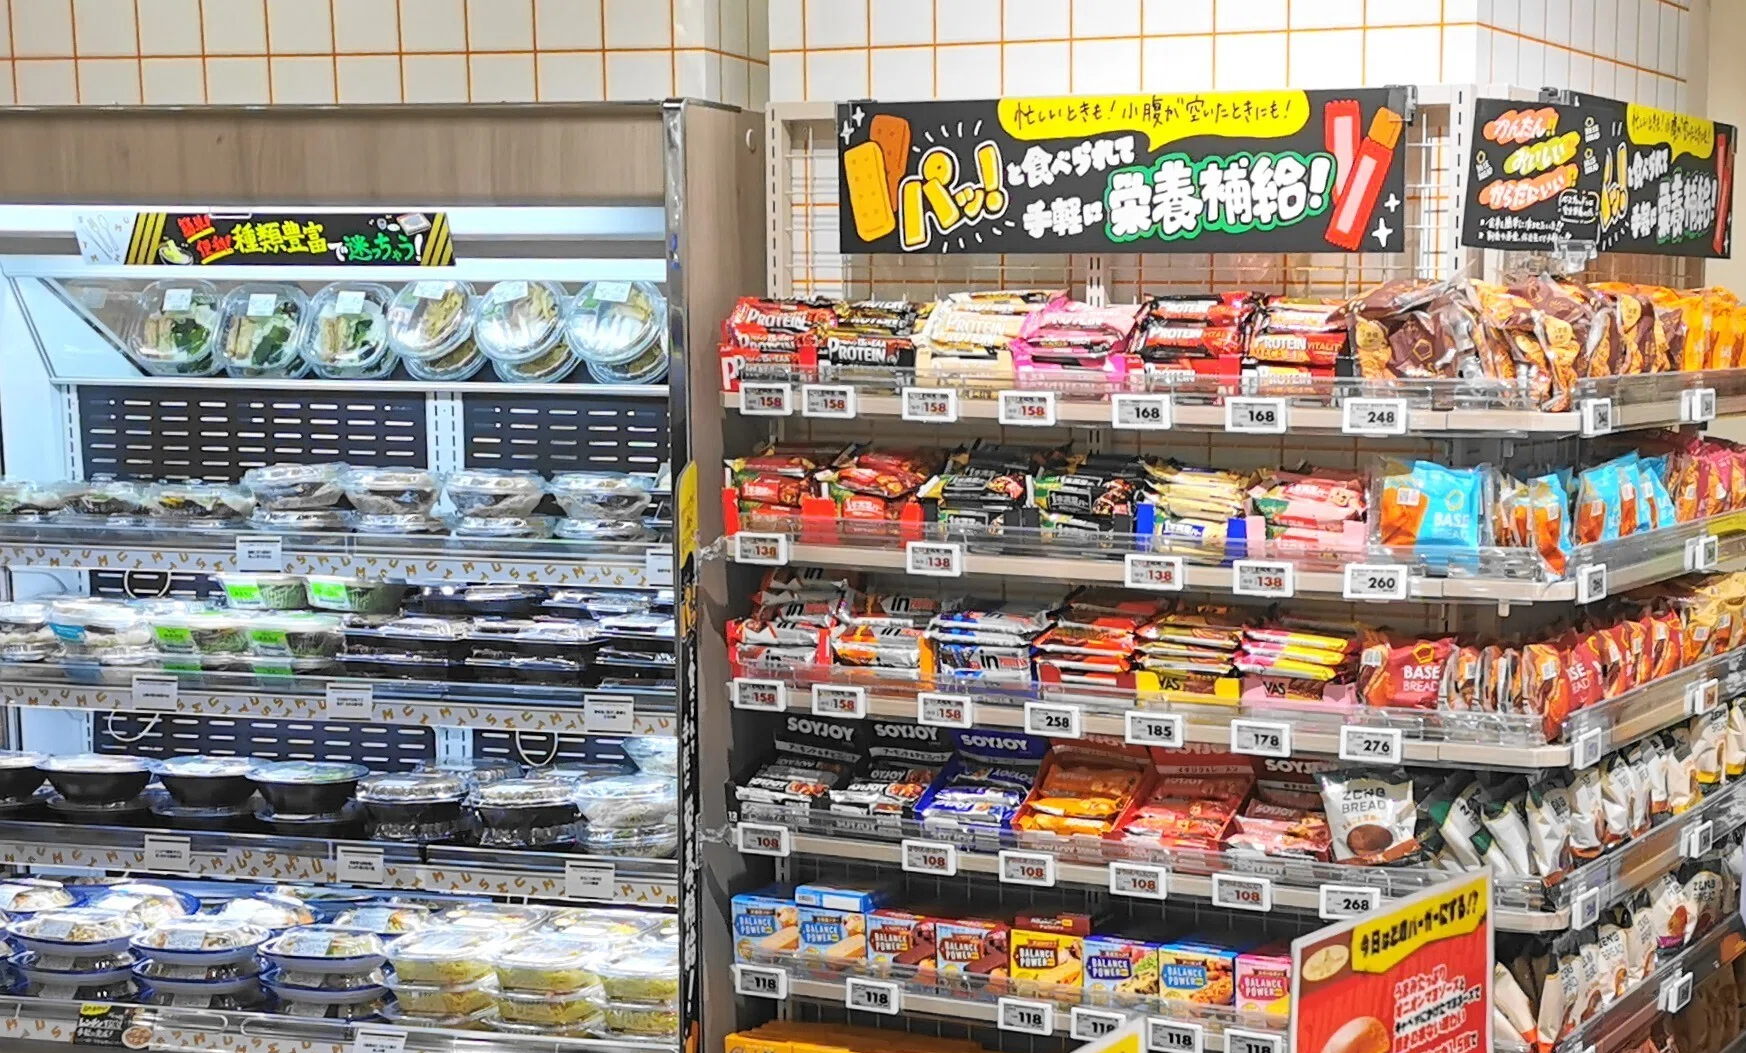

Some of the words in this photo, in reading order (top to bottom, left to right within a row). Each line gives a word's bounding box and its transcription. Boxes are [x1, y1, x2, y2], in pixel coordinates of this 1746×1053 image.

[1007, 136, 1135, 187] と食べられて
[1108, 152, 1334, 233] 栄養補給!
[1023, 199, 1103, 238] 手軽に
[1254, 335, 1307, 351] PROTEIN
[828, 337, 887, 363] PROTEIN
[760, 396, 782, 407] 158
[824, 399, 845, 410] 158
[924, 402, 946, 413] 158
[1021, 404, 1045, 416] 158
[1135, 406, 1160, 419] 168
[1248, 409, 1275, 423] 168
[1367, 410, 1394, 424] 248
[755, 545, 776, 557] 138
[928, 557, 950, 568] 138
[1148, 570, 1173, 582] 138
[1258, 577, 1282, 588] 138
[1368, 577, 1395, 589] 260
[787, 604, 803, 616] in
[890, 597, 909, 611] in
[980, 649, 999, 669] in
[1403, 664, 1440, 680] BASE
[754, 693, 776, 703] 158
[834, 699, 855, 711] 158
[940, 708, 962, 720] 158
[1046, 716, 1070, 728] 258
[787, 716, 855, 741] SOYJOY
[873, 723, 940, 741] SOYJOY
[1147, 725, 1172, 737] 185
[960, 734, 1028, 751] SOYJOY
[1253, 734, 1280, 746] 178
[1364, 739, 1390, 752] 276
[1342, 800, 1387, 814] BREAD
[757, 837, 779, 848] 108
[922, 855, 946, 866] 108
[1020, 866, 1044, 878] 108
[1132, 878, 1156, 890] 108
[1234, 889, 1260, 901] 108
[1343, 899, 1369, 911] 268
[740, 916, 771, 926] BALANCE
[741, 926, 766, 935] POWER
[805, 923, 838, 933] BALANCE
[806, 933, 832, 943] POWER
[874, 932, 907, 943] BALANCE
[876, 942, 901, 951] POWER
[944, 941, 978, 951] BALANCE
[946, 950, 971, 960] POWER
[1019, 948, 1055, 959] BALANCE
[1020, 958, 1048, 967] POWER
[1091, 958, 1128, 969] BALANCE
[1093, 968, 1121, 977] POWER
[1168, 966, 1203, 977] BALANCE
[754, 977, 776, 989] 118
[1169, 976, 1196, 986] POWER
[1245, 976, 1282, 988] BALANCE
[866, 991, 888, 1004] 118
[1246, 987, 1274, 997] POWER
[1018, 1012, 1042, 1025] 118
[1168, 1033, 1192, 1046] 118
